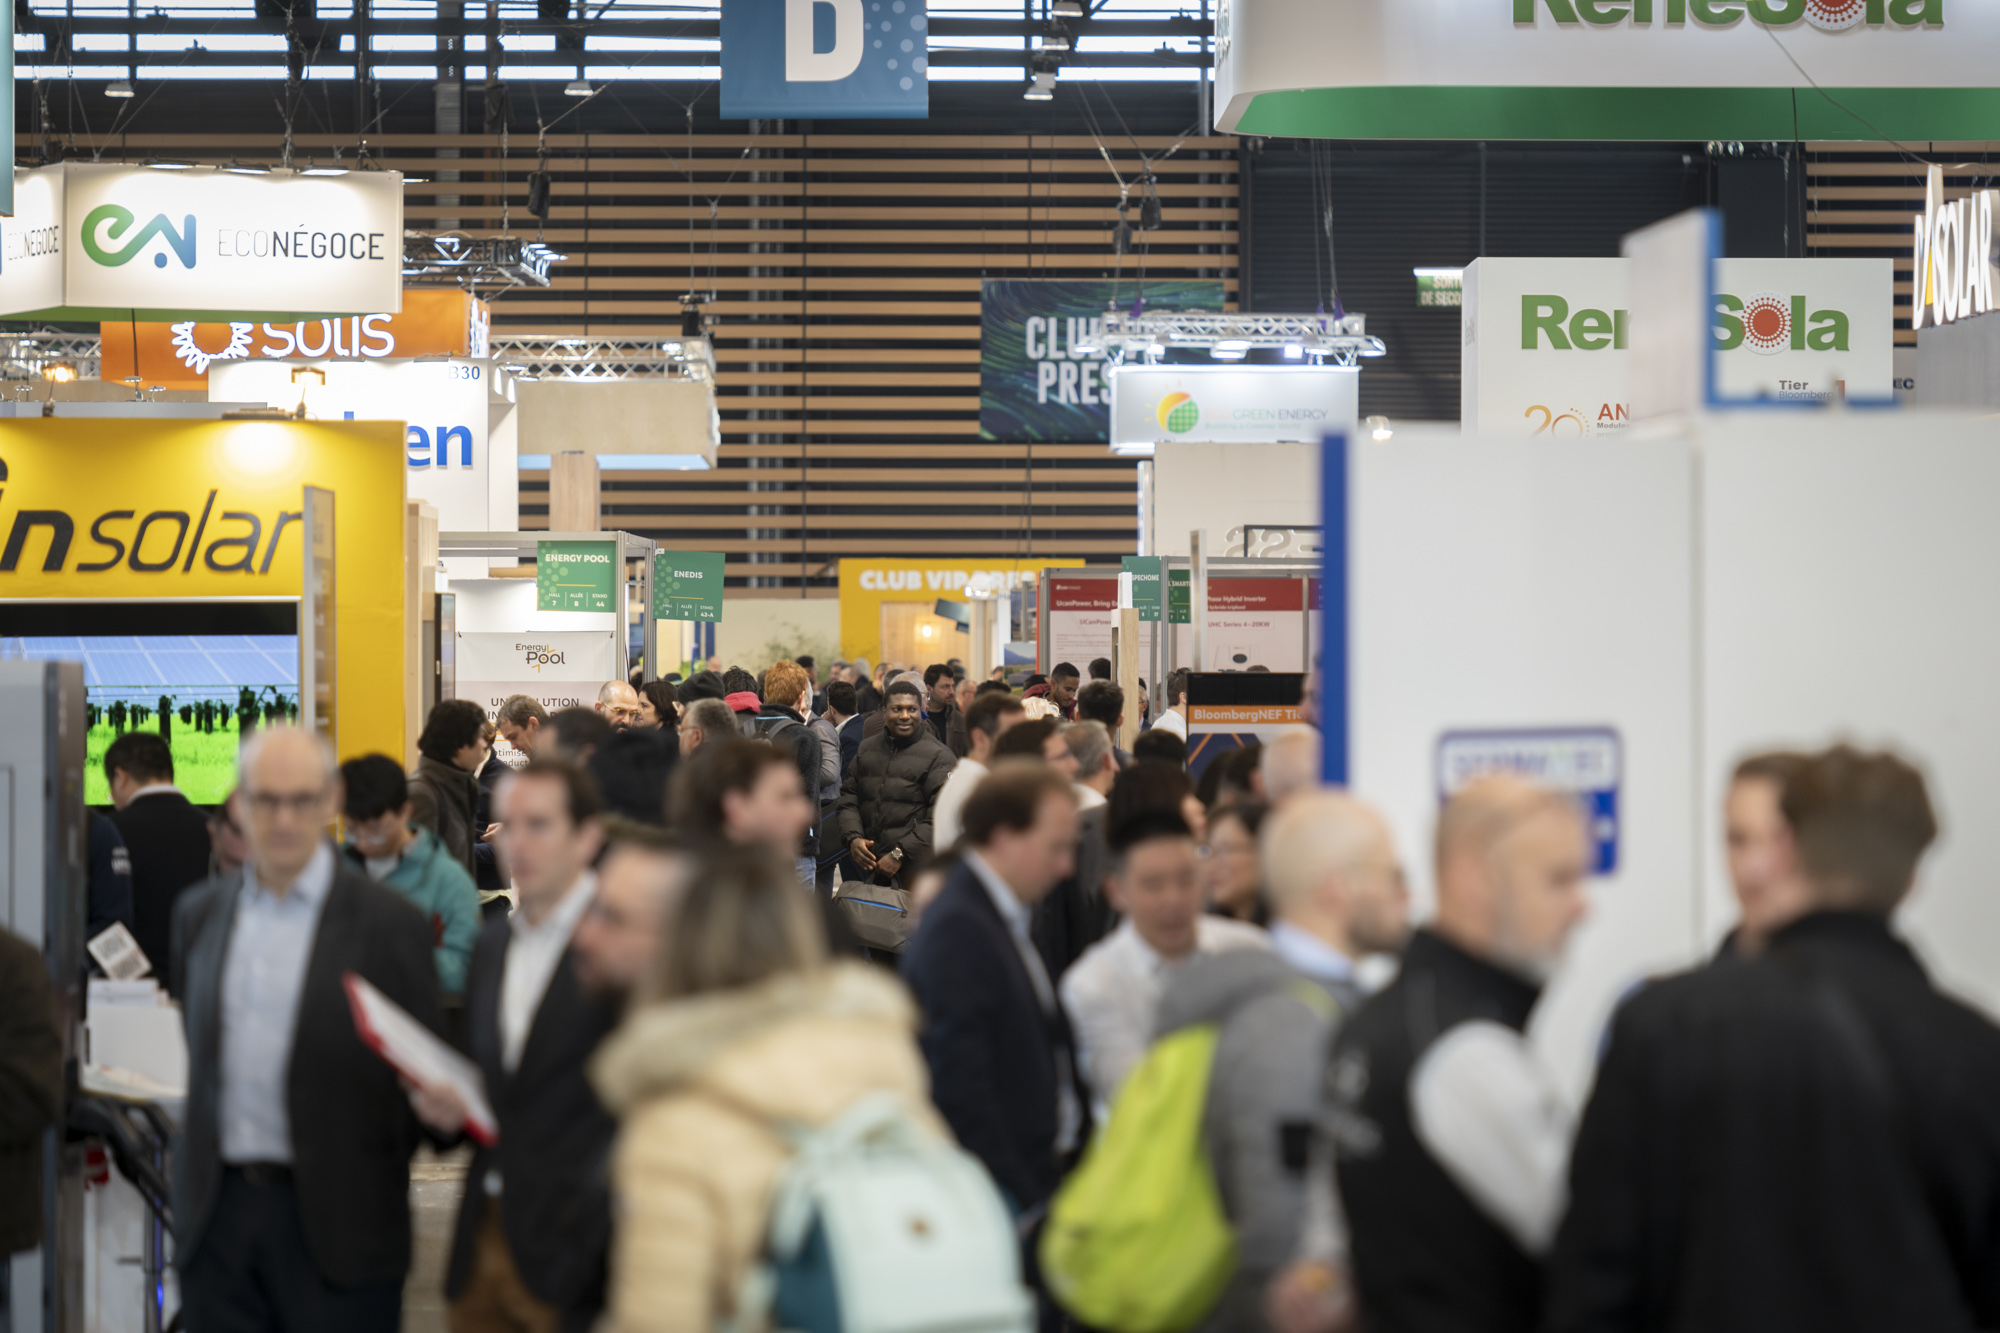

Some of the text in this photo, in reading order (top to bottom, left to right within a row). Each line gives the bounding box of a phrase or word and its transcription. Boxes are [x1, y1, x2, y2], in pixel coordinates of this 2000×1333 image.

[218, 223, 385, 261] ECONÉGOCE
[1421, 291, 1434, 305] DE
[448, 365, 480, 380] B30
[1779, 380, 1809, 390] Tier
[1892, 378, 1915, 390] EC
[1279, 409, 1328, 420] ENERGY
[545, 554, 610, 564] ENERGY POOL
[673, 570, 704, 580] ENEDIS
[859, 569, 922, 590] CLUB
[925, 569, 969, 590] VIP
[515, 643, 547, 653] Energy
[525, 651, 566, 665] Pool
[1194, 709, 1283, 722] BloombergNEF
